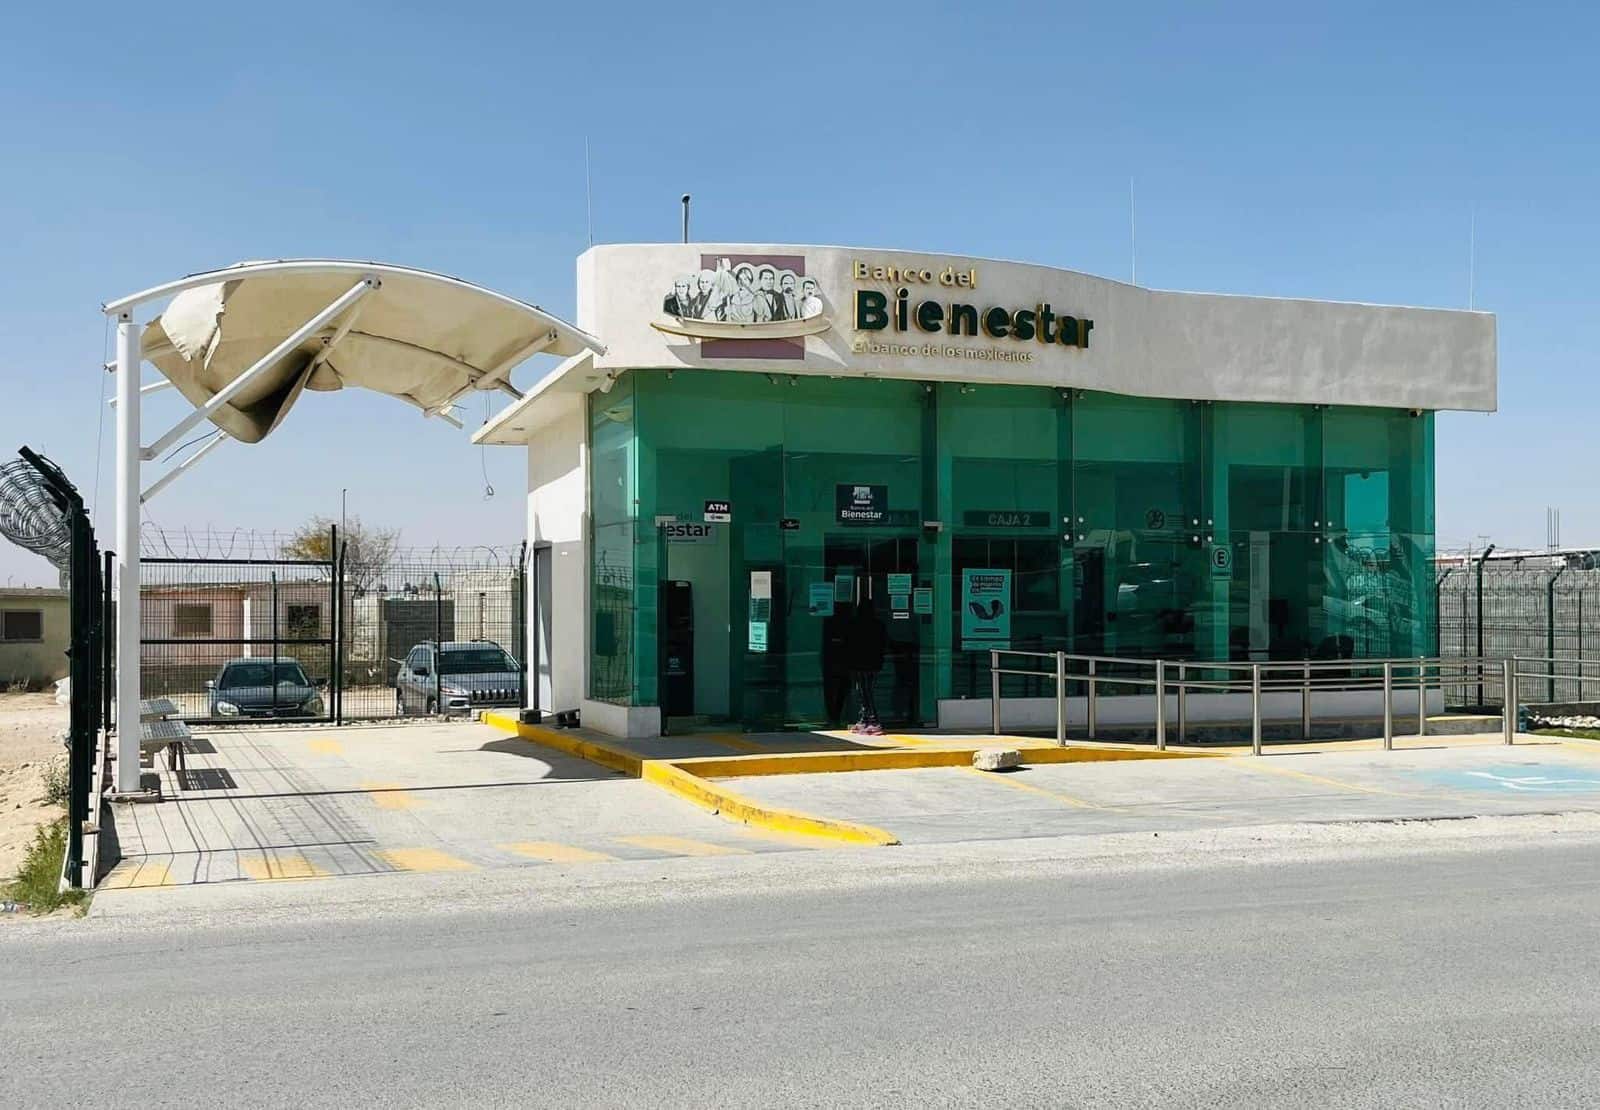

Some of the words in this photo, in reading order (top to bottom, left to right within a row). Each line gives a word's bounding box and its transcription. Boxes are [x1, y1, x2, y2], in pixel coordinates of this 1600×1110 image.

[853, 260, 933, 284] Banco
[940, 266, 977, 289] del
[853, 288, 1094, 349] Bienestar
[870, 341, 918, 356] banco
[921, 343, 938, 357] de
[941, 343, 962, 358] los
[963, 346, 1034, 362] mexicanos
[708, 504, 728, 512] ATM
[841, 510, 883, 520] Bienestar
[988, 514, 1019, 526] CAJA
[1024, 514, 1032, 526] 2
[662, 523, 712, 537] estar
[1217, 551, 1226, 565] E
